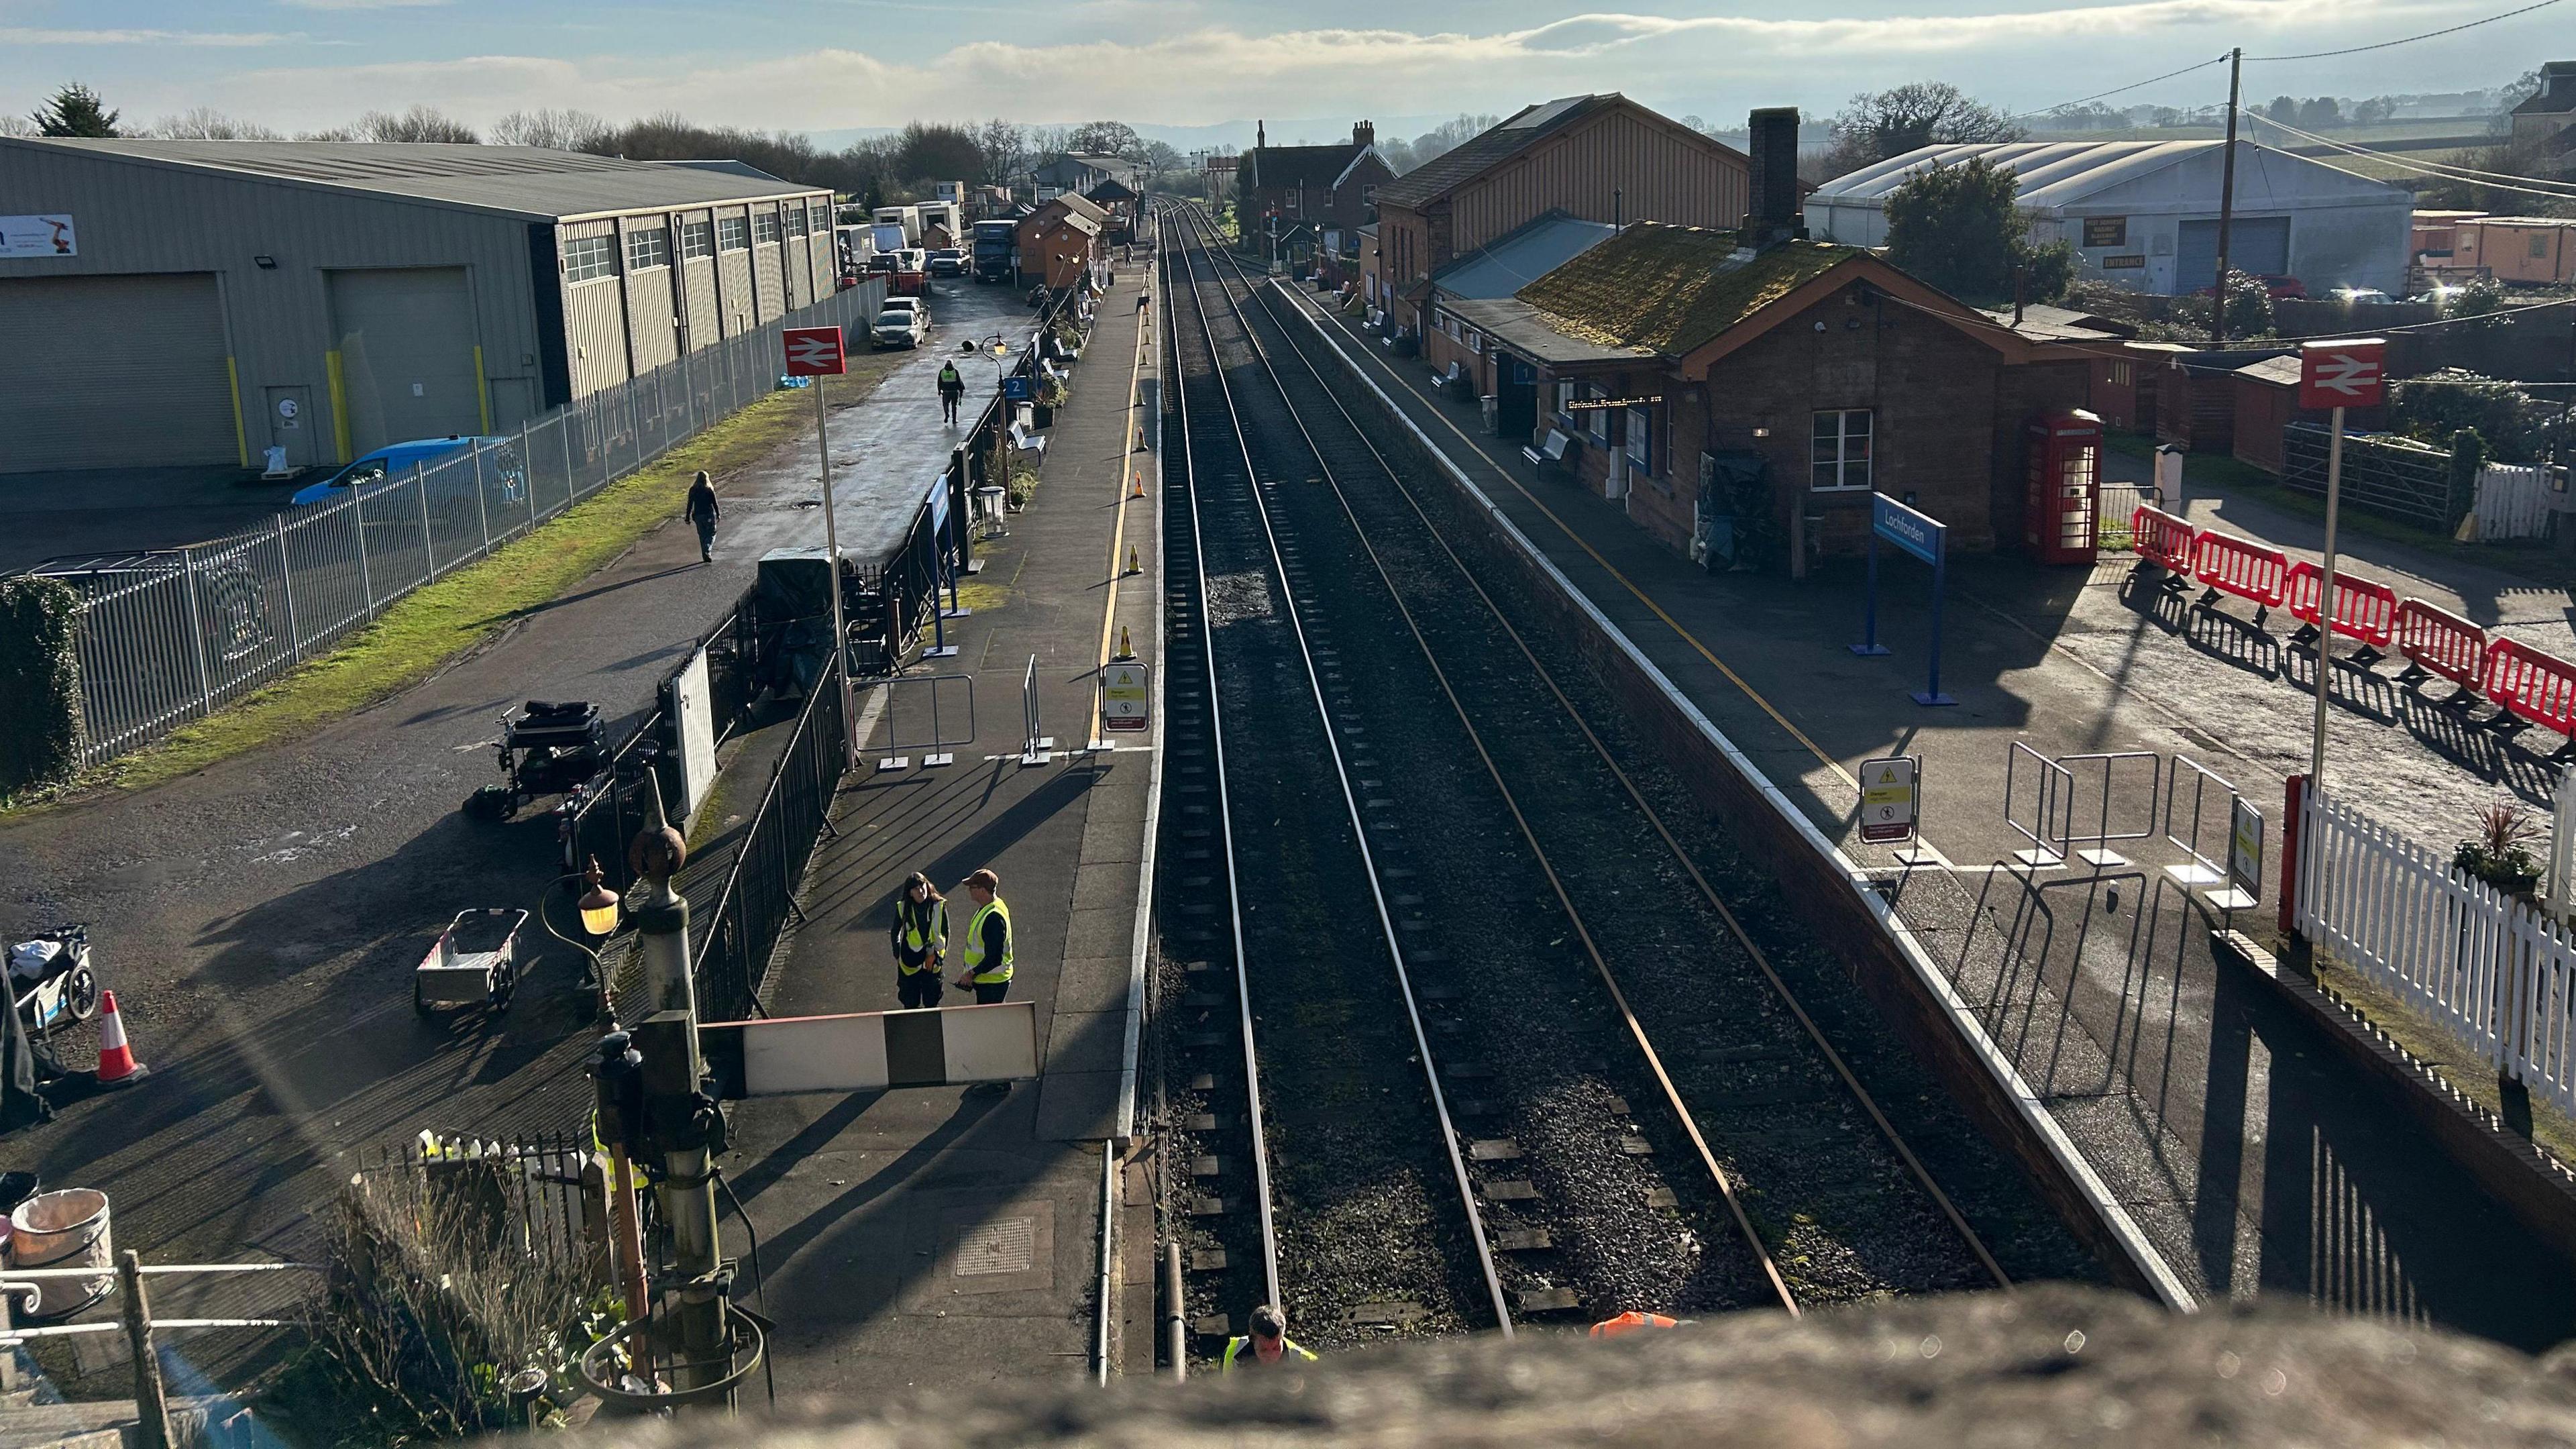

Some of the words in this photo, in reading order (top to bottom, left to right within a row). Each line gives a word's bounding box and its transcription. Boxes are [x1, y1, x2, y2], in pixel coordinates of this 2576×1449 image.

[2105, 257, 2143, 268] ENTRANCE
[1523, 367, 1528, 378] 1
[1012, 380, 1020, 392] 2
[1885, 508, 1924, 544] Lochforden
